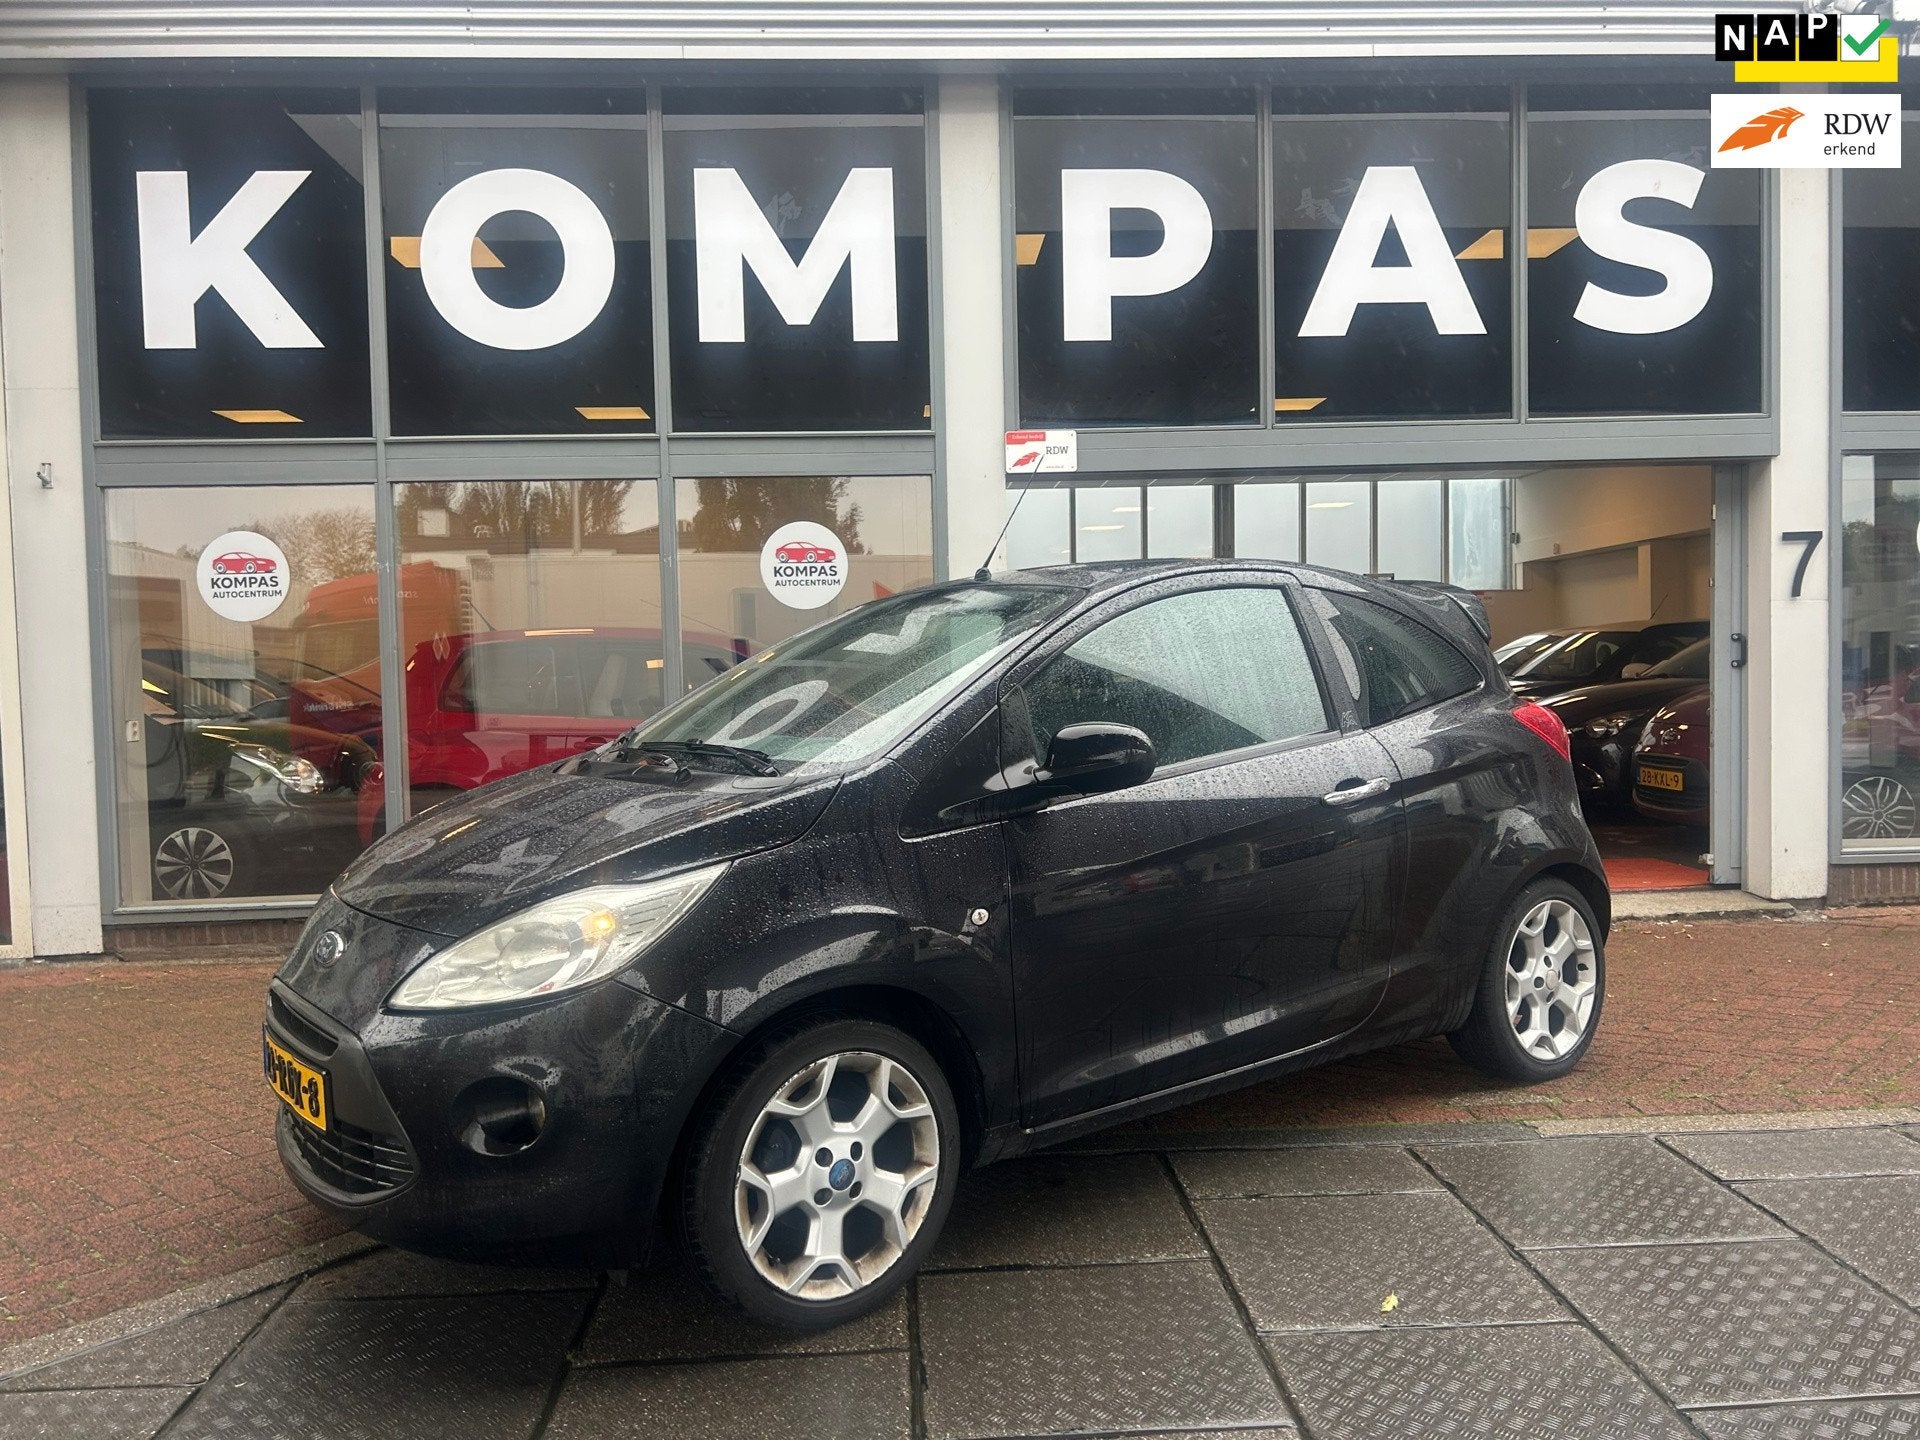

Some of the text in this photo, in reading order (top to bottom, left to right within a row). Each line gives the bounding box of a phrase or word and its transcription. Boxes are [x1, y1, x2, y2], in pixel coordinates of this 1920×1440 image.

[1046, 446, 1069, 455] RDW
[1781, 530, 1823, 598] 7
[774, 565, 838, 577] KOMPAS
[211, 575, 279, 589] KOMPAS
[775, 579, 841, 587] AUTOCENTRUM
[212, 589, 282, 599] AUTOCENTRUM
